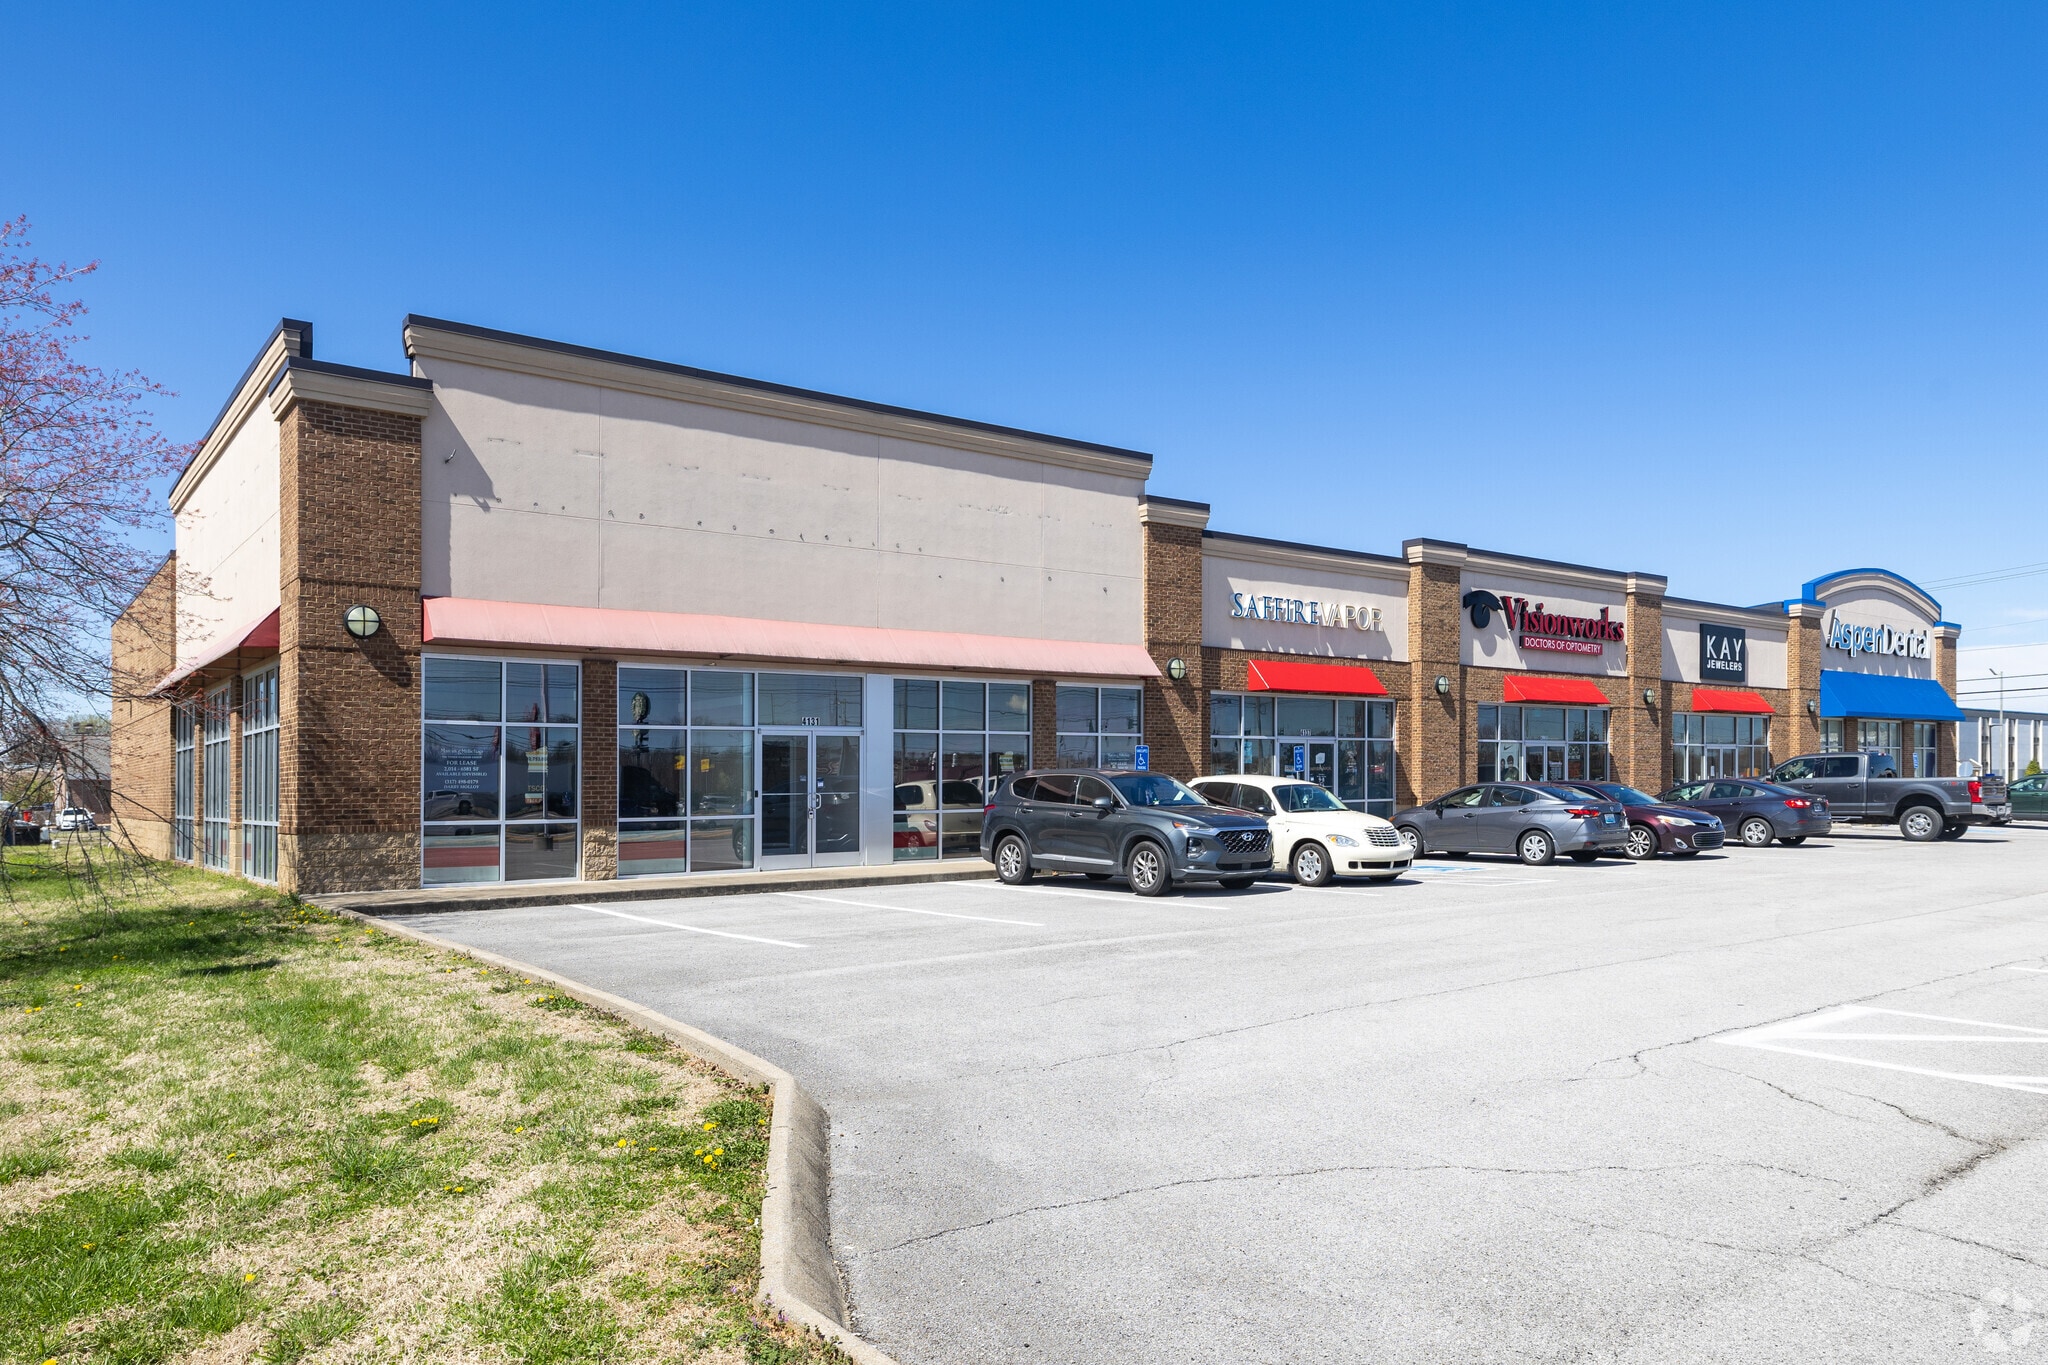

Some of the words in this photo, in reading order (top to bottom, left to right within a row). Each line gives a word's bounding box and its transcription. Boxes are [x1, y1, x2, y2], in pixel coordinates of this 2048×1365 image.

[1500, 595, 1624, 642] Visionworks
[1525, 637, 1556, 649] DOCTORS
[1556, 640, 1565, 651] OF
[1566, 641, 1601, 654] OPTOMETRY
[1706, 634, 1743, 661] KAY
[1706, 659, 1743, 671] JEWELERS
[801, 716, 820, 726] 4131
